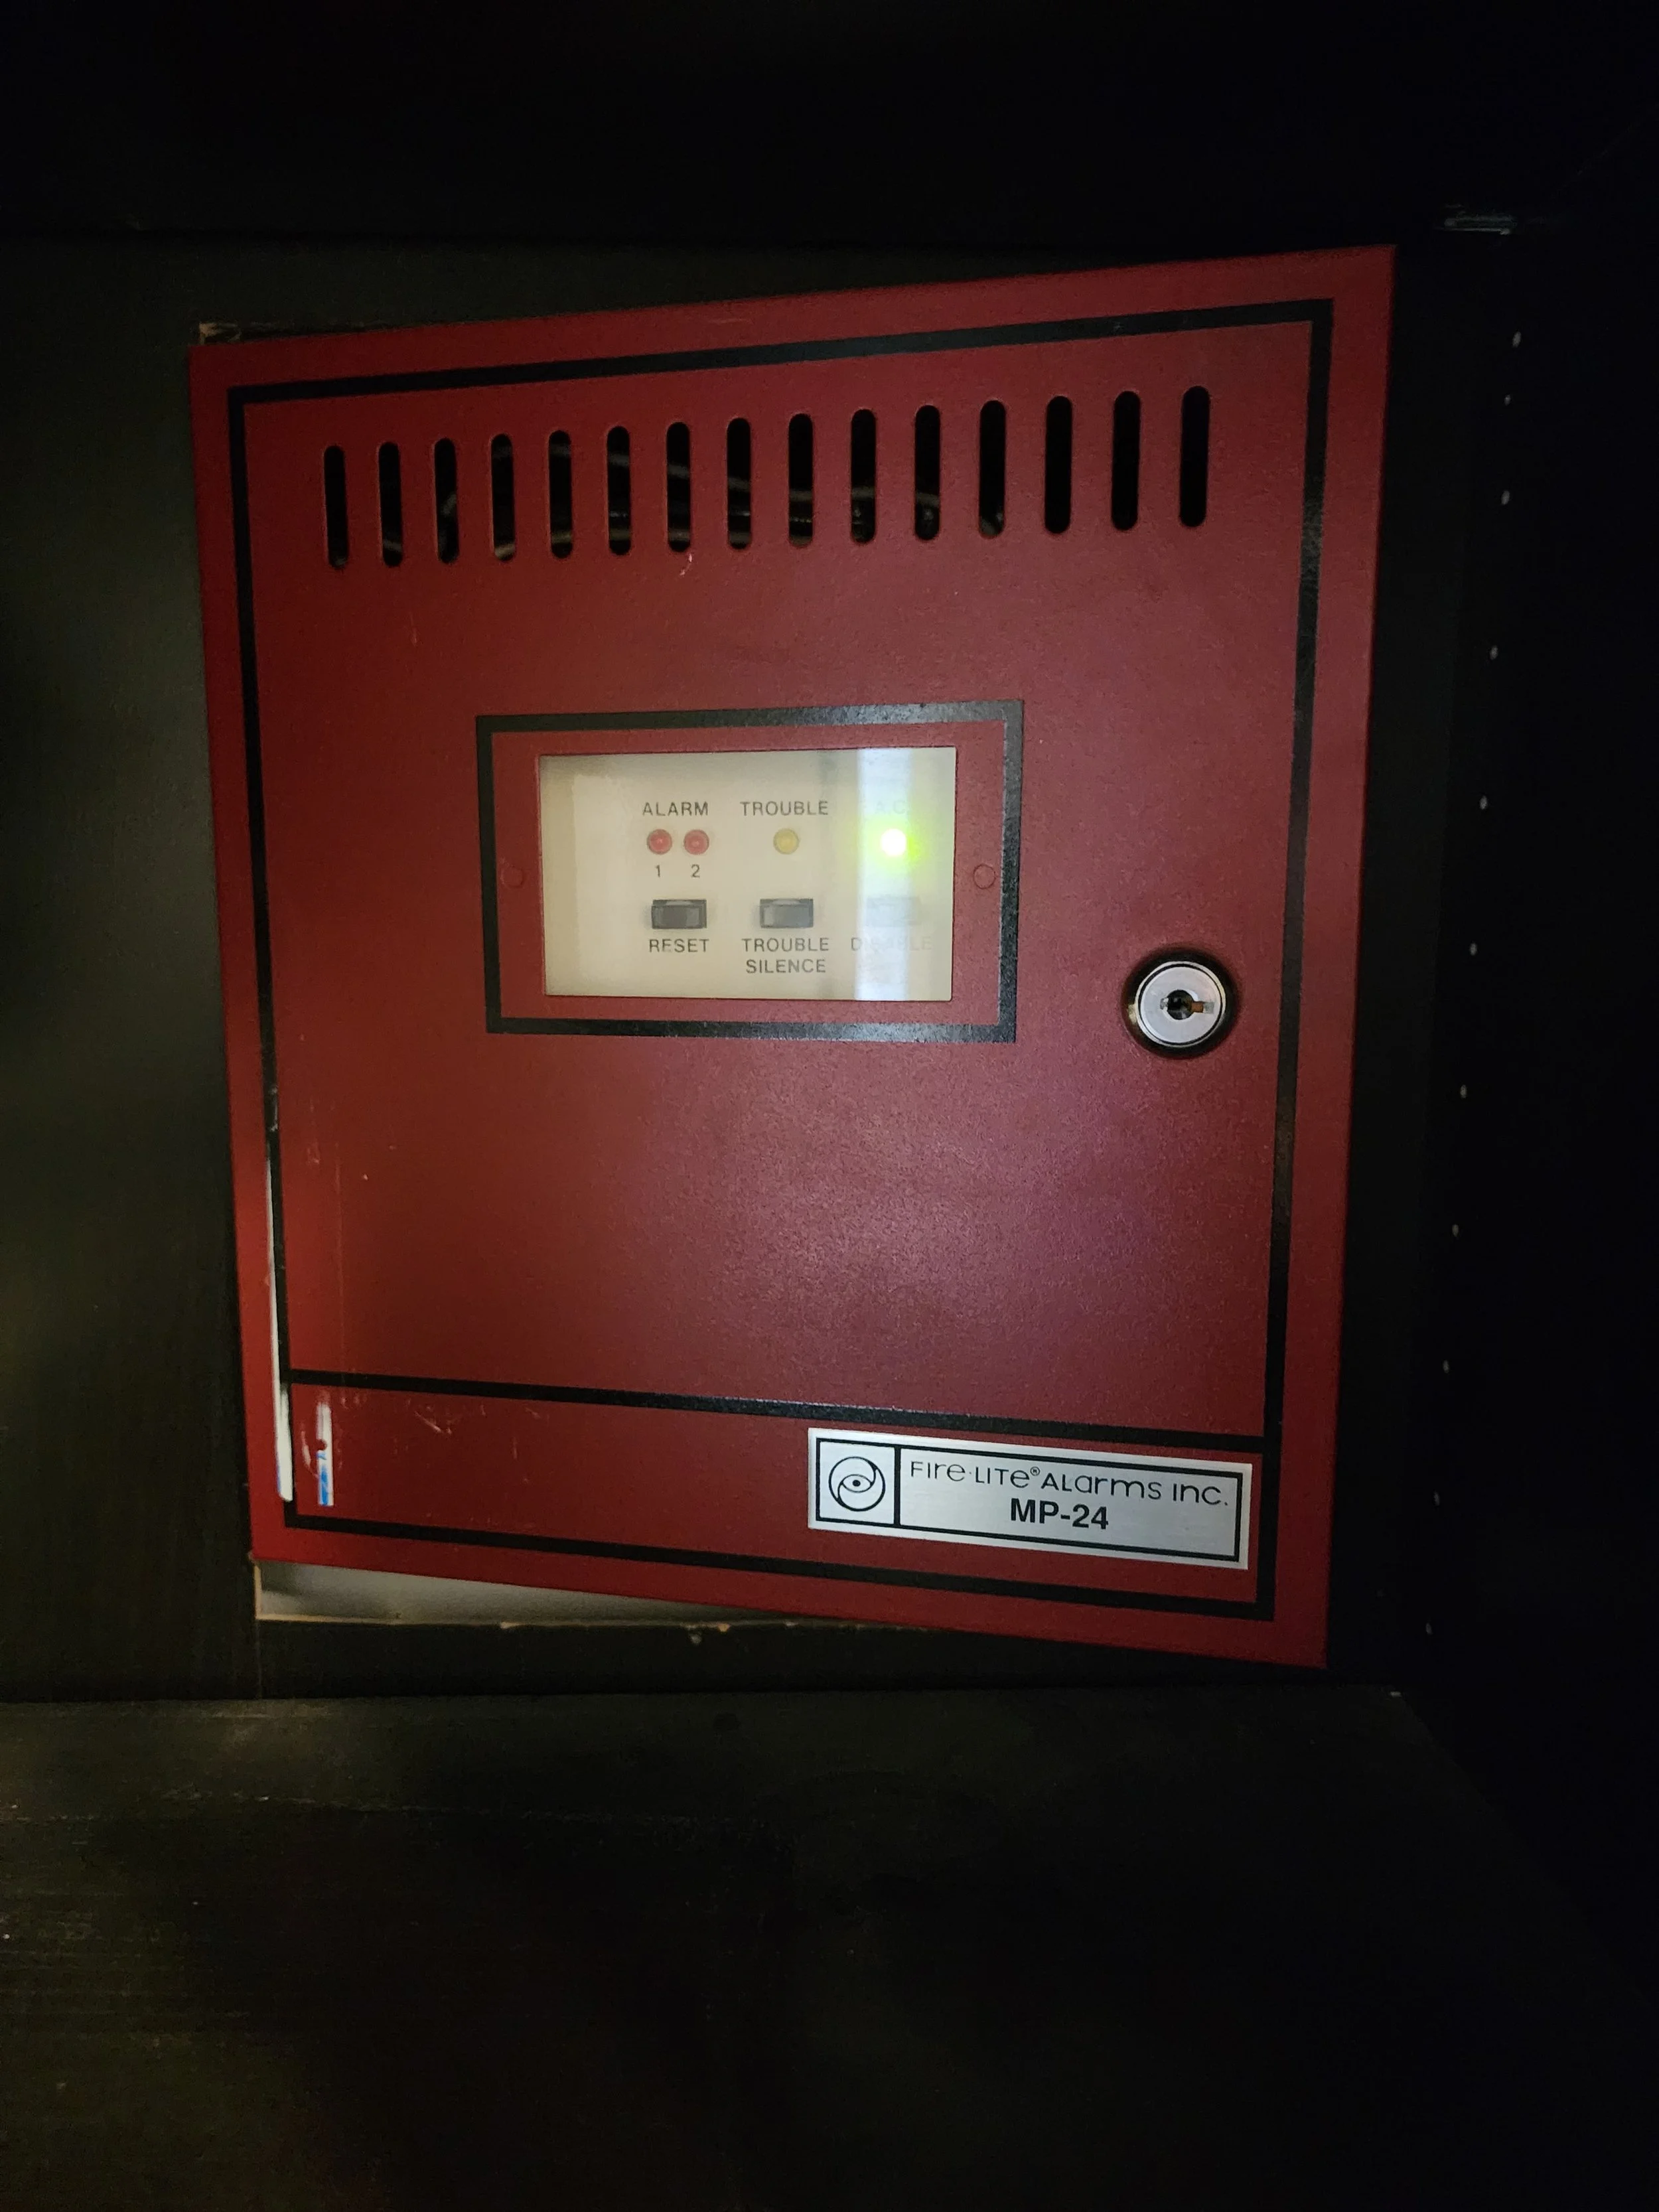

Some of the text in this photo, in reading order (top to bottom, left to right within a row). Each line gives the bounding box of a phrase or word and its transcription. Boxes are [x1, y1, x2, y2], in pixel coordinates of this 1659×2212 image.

[642, 801, 709, 816] ALARM
[740, 800, 829, 816] TROUBLE
[655, 864, 701, 878] 1 2
[649, 938, 710, 953] RESET
[742, 938, 830, 952] TROUBLE
[746, 959, 826, 974] SILENCE
[1173, 1483, 1228, 1506] Inc.
[1011, 1498, 1109, 1530] MP-24
